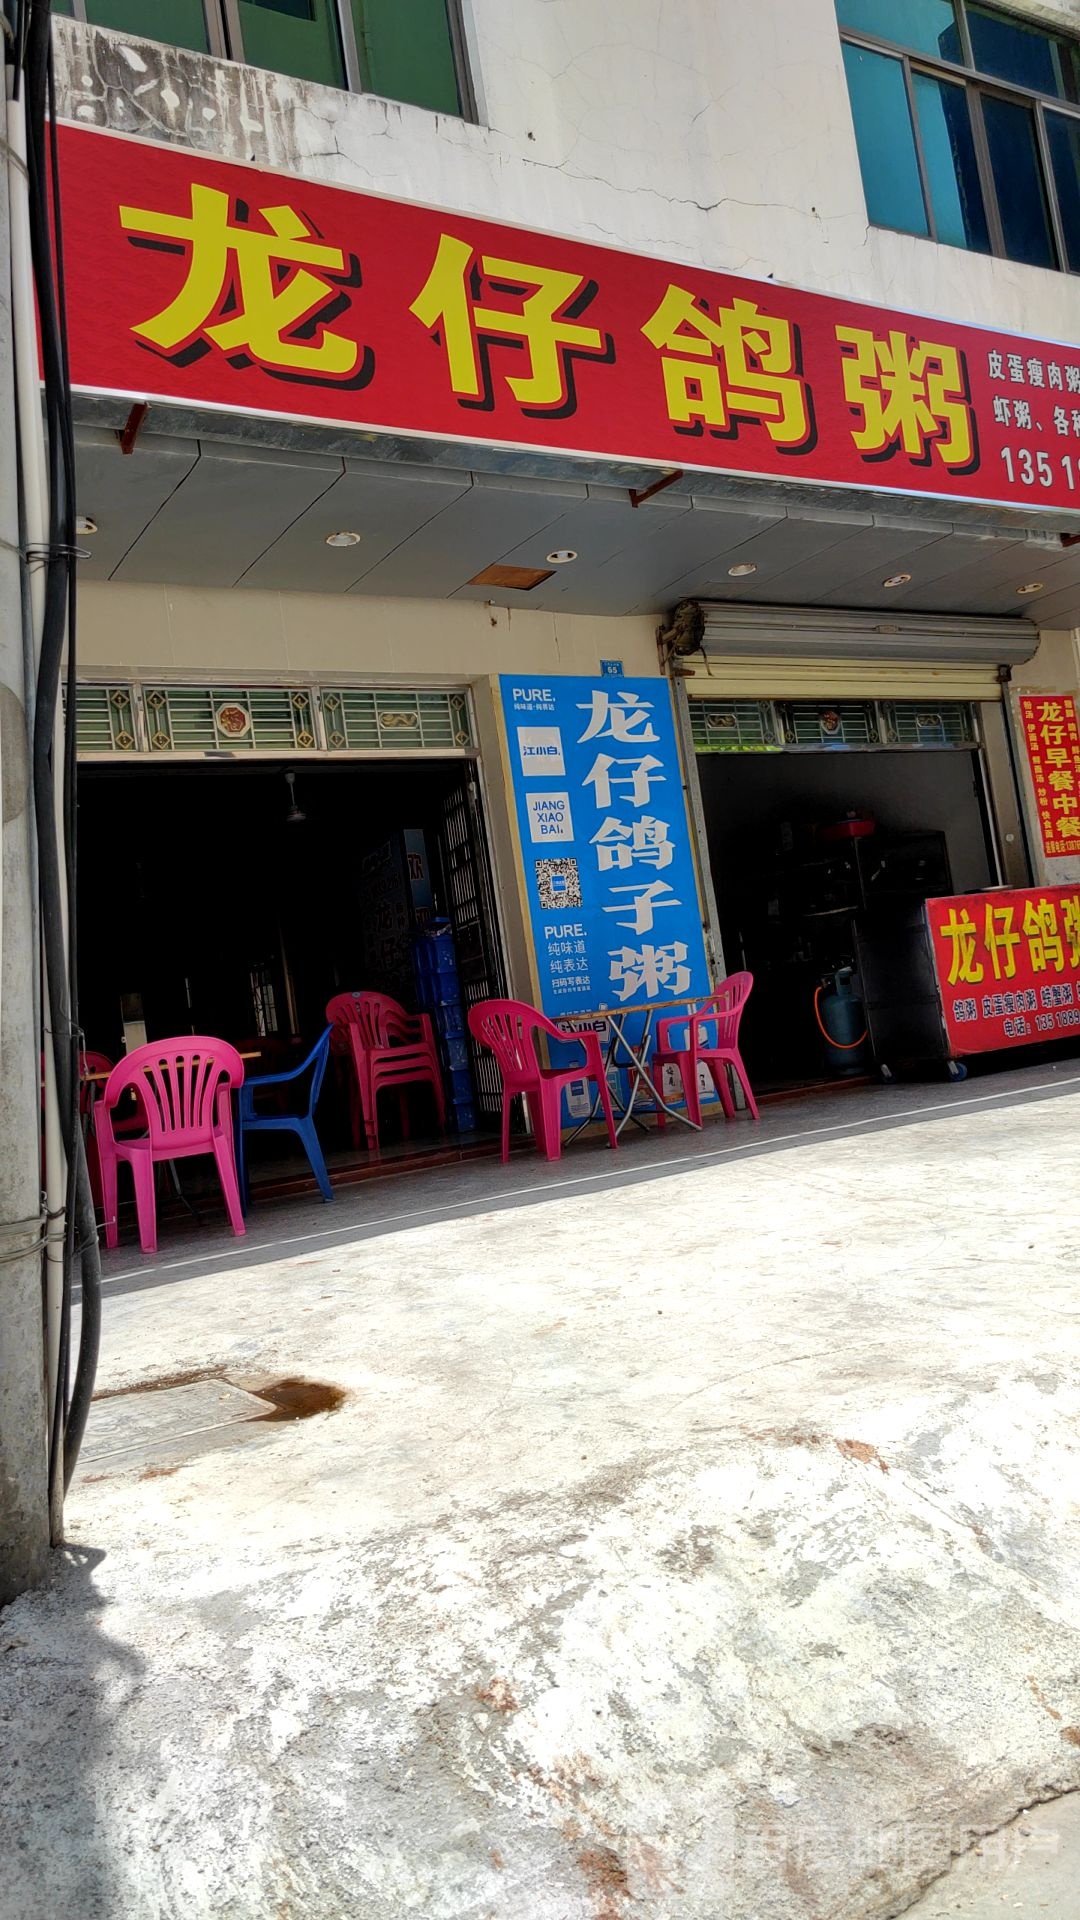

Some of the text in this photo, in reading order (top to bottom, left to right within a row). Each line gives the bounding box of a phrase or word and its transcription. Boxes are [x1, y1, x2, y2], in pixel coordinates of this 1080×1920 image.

[119, 183, 972, 464] 龙仔鸽粥
[987, 350, 1080, 393] 皮蛋瘦肉粥
[1061, 455, 1080, 490] 1
[512, 688, 556, 702] PURE.
[1037, 702, 1080, 838] 龙仔早餐中餐
[533, 800, 565, 811] JIANG
[537, 813, 564, 823] XIAO
[576, 690, 692, 1001] 龙仔鸽子粥
[544, 923, 587, 939] PURE.
[547, 940, 586, 956] 纯味道
[550, 957, 589, 974] 纯表达
[552, 975, 590, 988] 扫码写表达
[953, 998, 977, 1023] 鸽粥
[982, 989, 1038, 1018] 皮蛋瘦肉粥
[1035, 1014, 1054, 1032] 135
